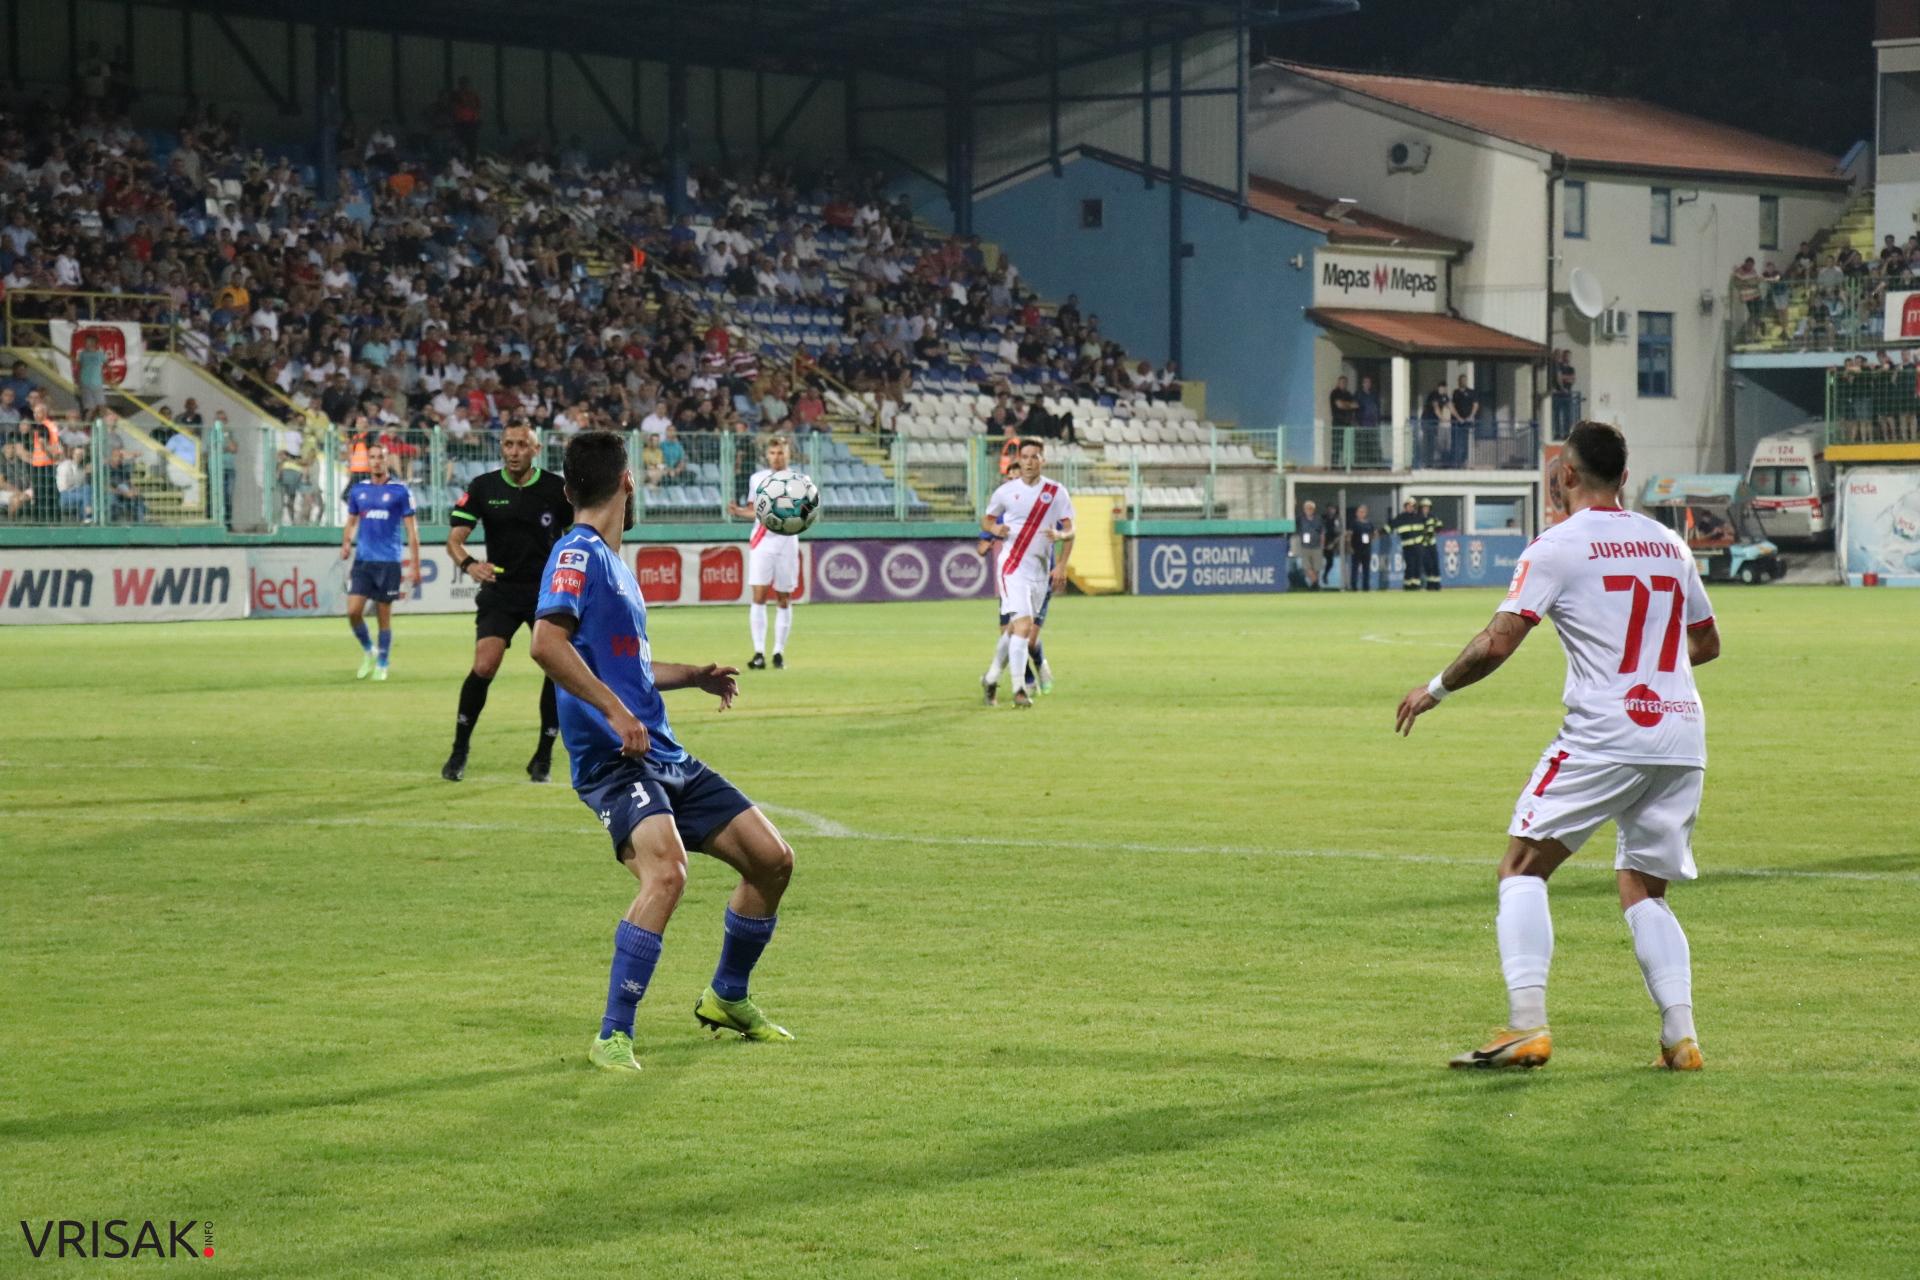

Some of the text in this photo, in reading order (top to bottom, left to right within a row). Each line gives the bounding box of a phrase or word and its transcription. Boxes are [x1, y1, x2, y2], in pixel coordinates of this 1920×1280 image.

[1323, 263, 1370, 294] Mepas
[1391, 267, 1437, 298] Mepas
[560, 553, 585, 565] EP
[1192, 547, 1250, 565] CROATIA
[250, 566, 318, 610] leda
[1192, 567, 1275, 585] OSIGURANJE
[1602, 575, 1685, 674] 77
[630, 781, 650, 809] 3
